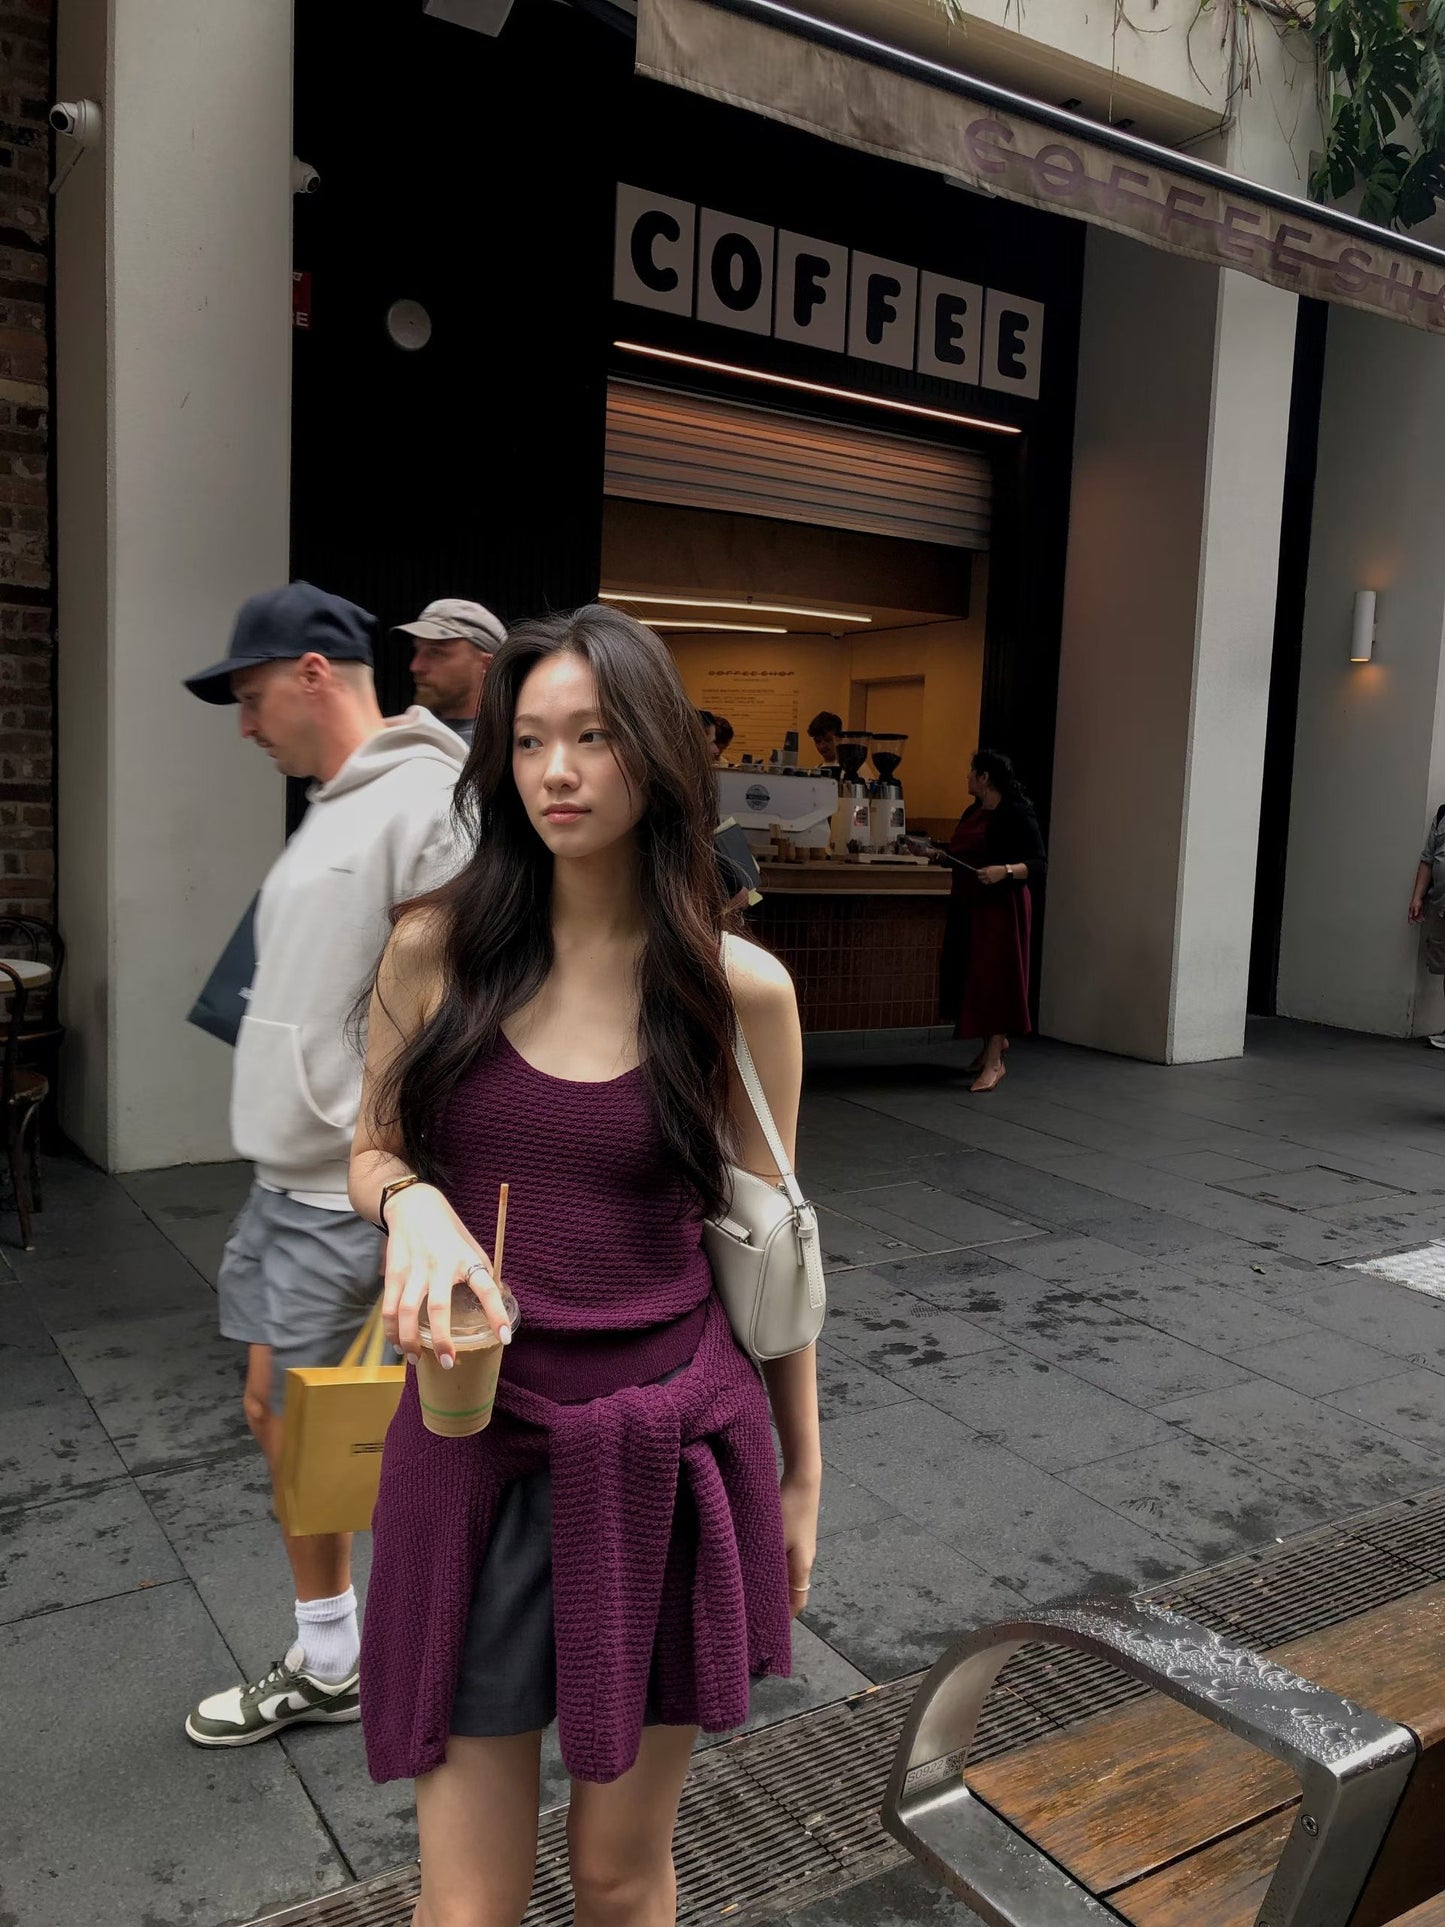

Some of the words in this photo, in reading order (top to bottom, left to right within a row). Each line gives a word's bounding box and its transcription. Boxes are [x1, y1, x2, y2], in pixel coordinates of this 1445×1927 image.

[631, 210, 1029, 379] COFFEE
[963, 117, 1312, 276] COFFEE
[1335, 247, 1445, 314] SH
